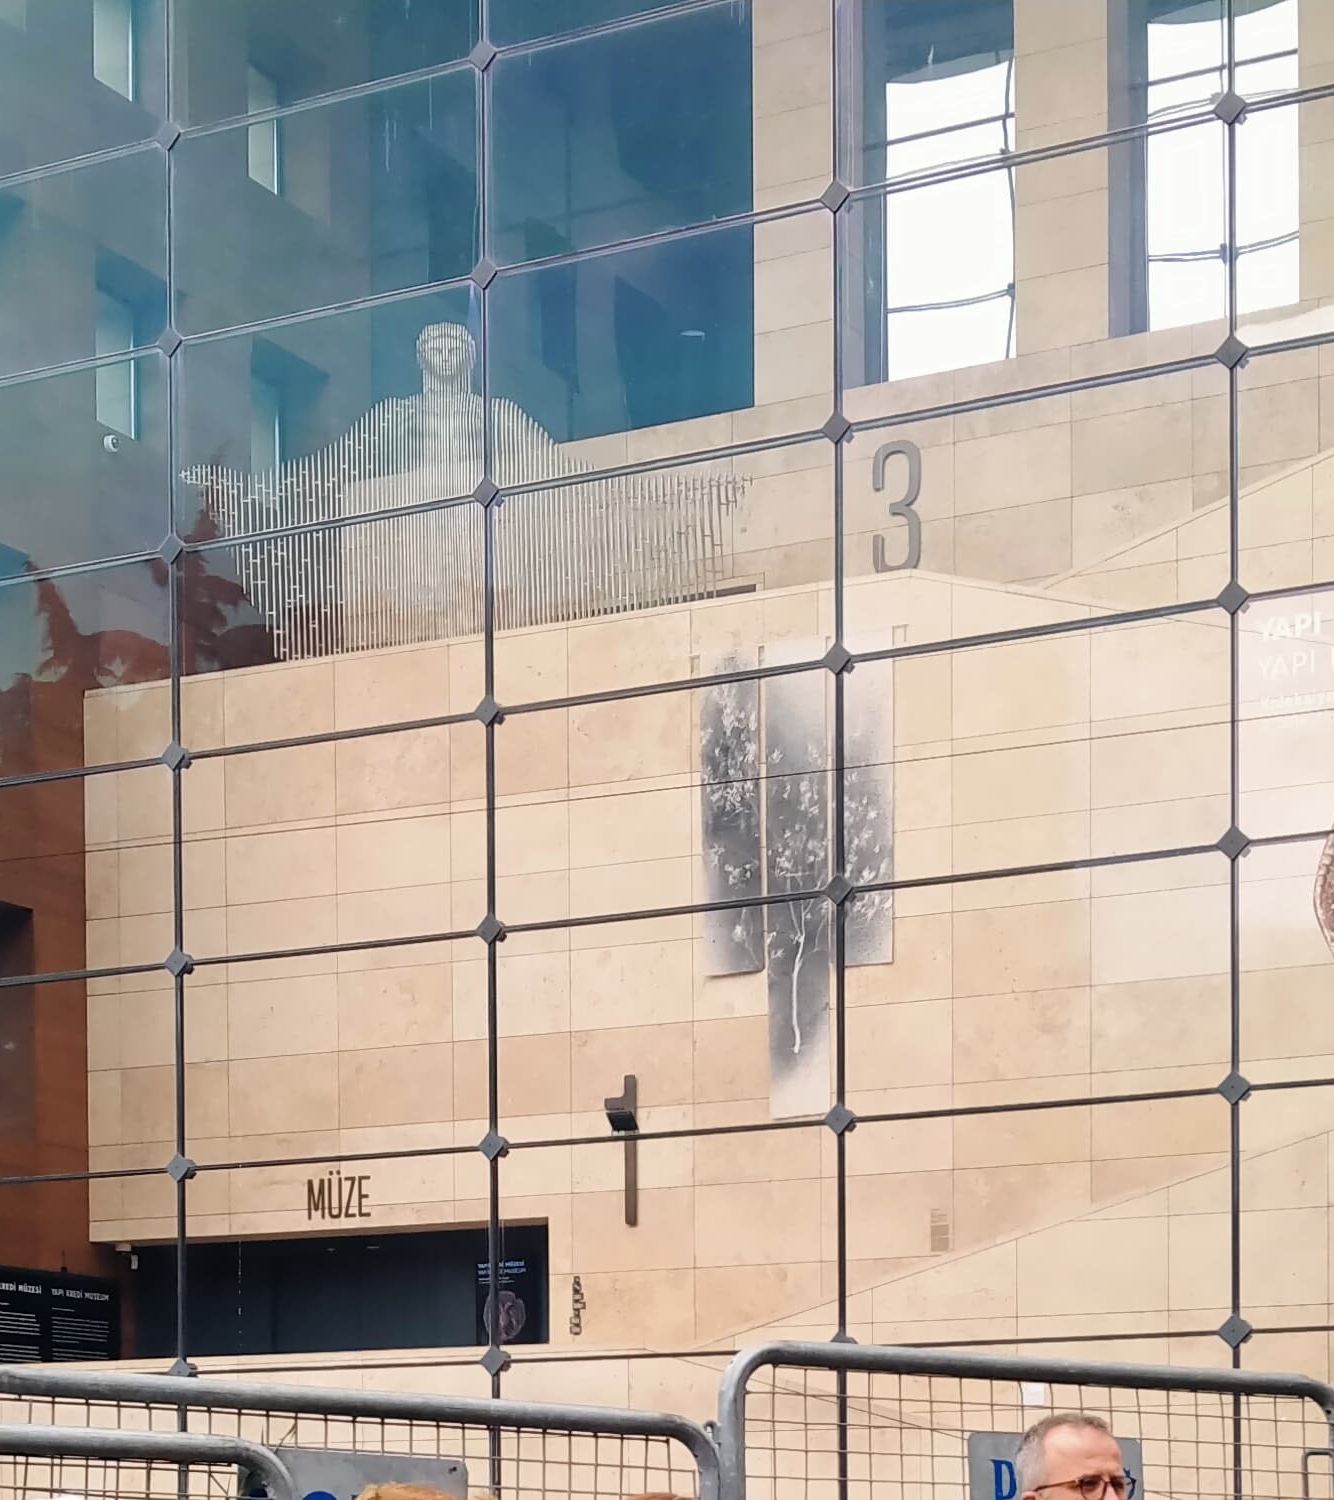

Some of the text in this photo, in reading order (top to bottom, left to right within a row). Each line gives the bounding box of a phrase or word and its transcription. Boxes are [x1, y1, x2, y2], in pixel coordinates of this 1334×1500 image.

[872, 439, 922, 573] 3
[1255, 610, 1320, 640] YAPI
[1258, 649, 1315, 680] YAPI
[307, 1169, 372, 1221] MÜZE
[18, 1282, 43, 1295] MÜZESİ
[85, 1291, 110, 1302] MUSEUM
